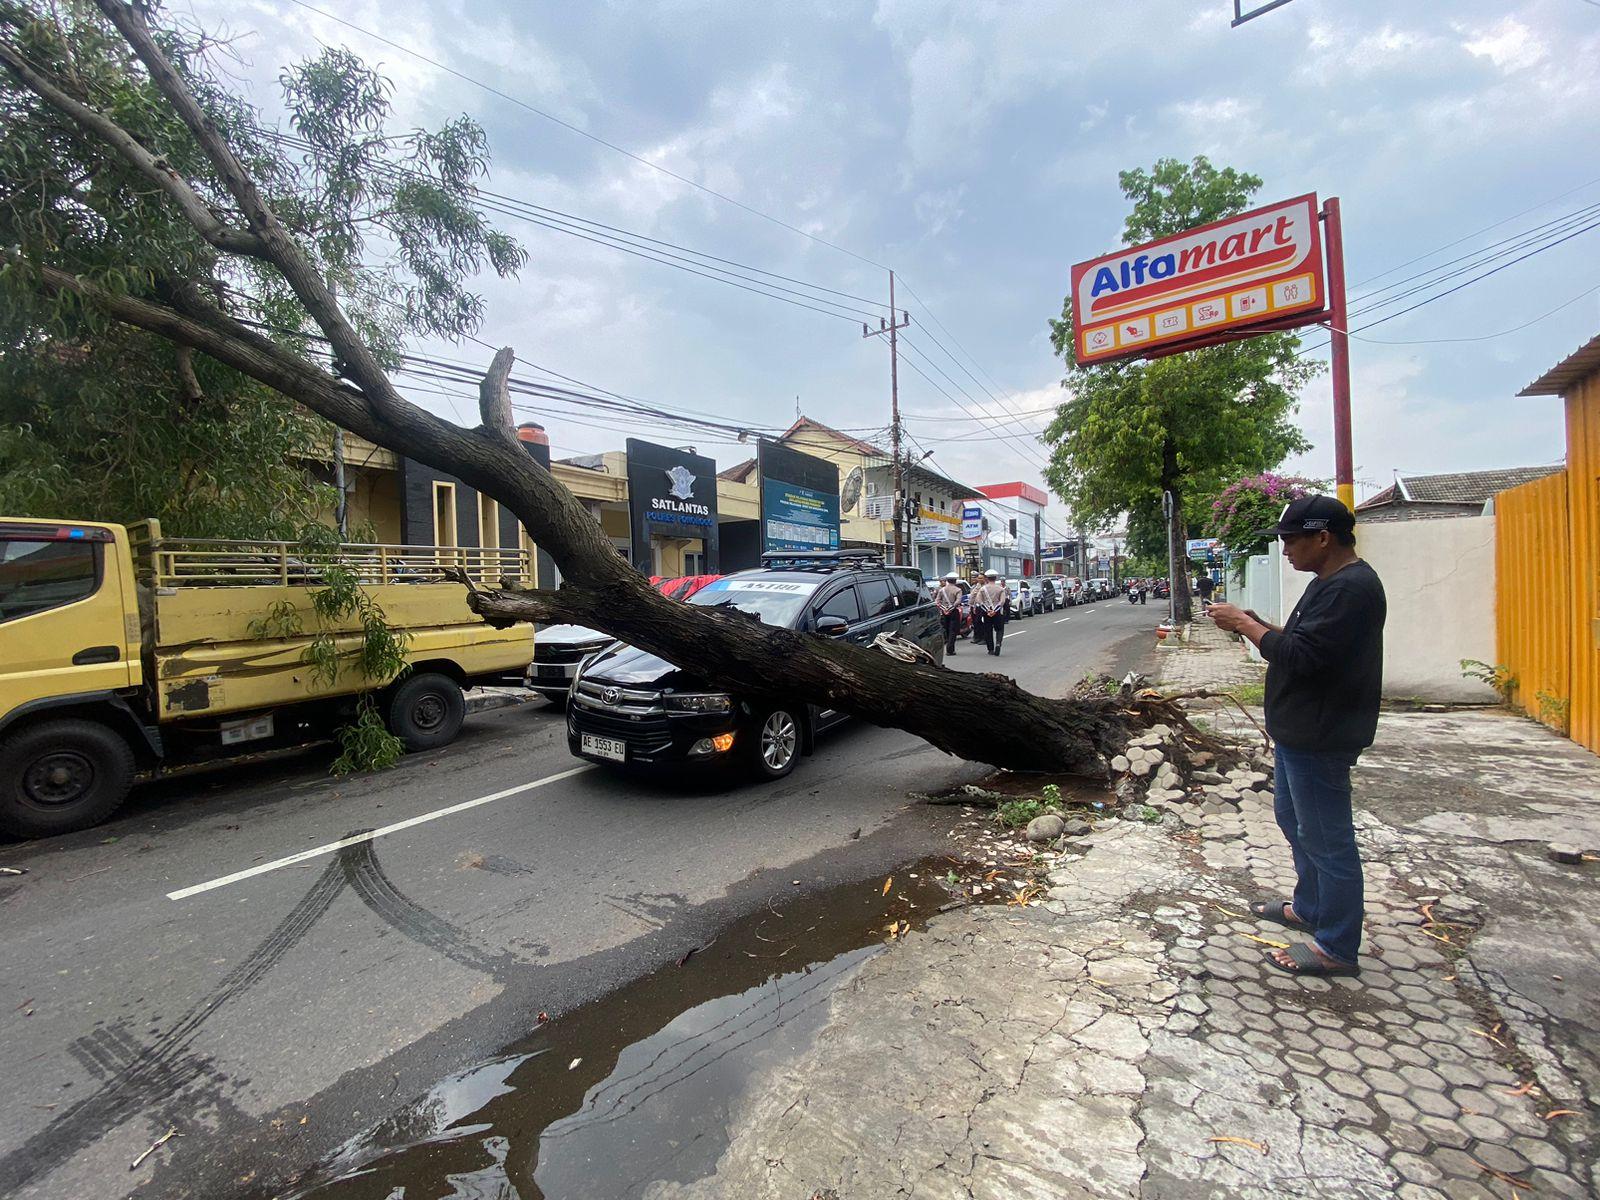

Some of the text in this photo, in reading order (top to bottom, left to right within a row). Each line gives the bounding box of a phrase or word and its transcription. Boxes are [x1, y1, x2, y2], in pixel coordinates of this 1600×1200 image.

[1091, 215, 1294, 298] Alfamart
[651, 498, 709, 516] SATLANTAS
[741, 582, 801, 591] ASTRO
[583, 736, 592, 748] AE
[594, 738, 612, 752] 1553
